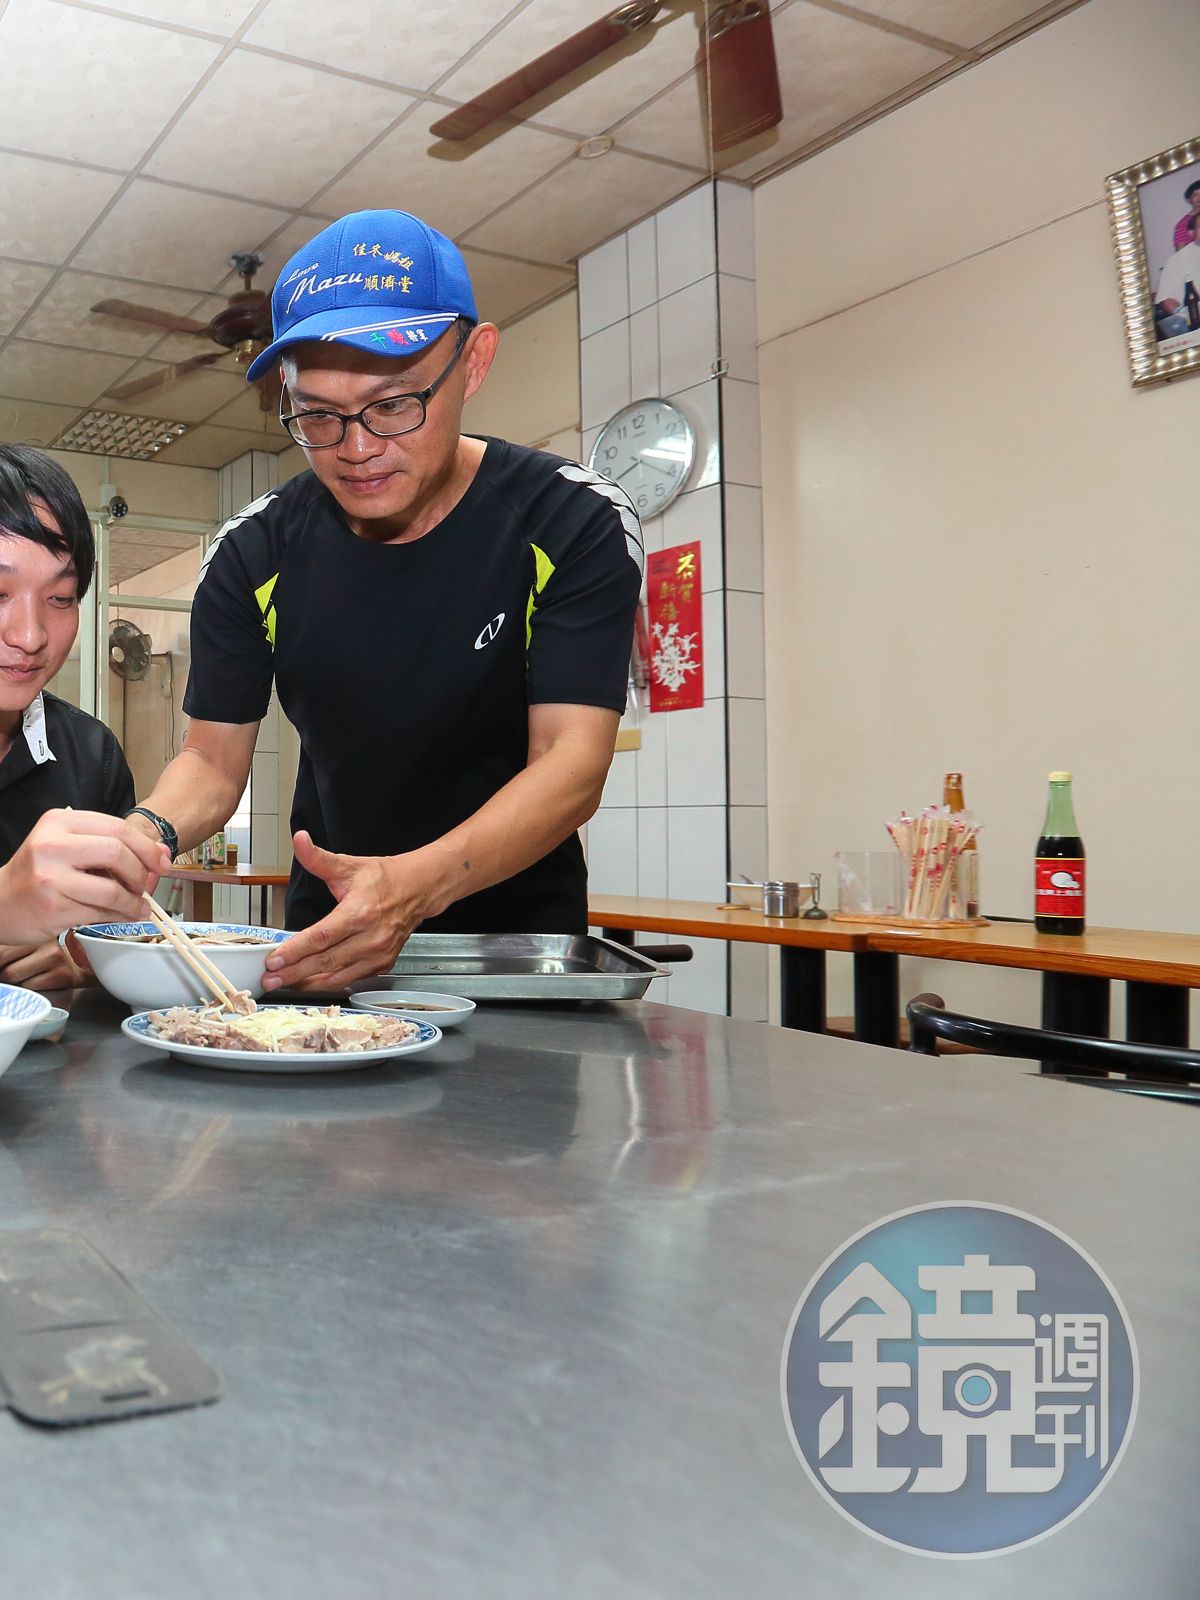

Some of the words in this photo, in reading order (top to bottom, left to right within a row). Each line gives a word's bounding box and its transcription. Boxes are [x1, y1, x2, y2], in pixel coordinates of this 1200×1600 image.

[286, 272, 364, 314] Mazu
[632, 414, 646, 430] 12
[617, 425, 627, 441] 11
[603, 445, 619, 460] 10
[655, 482, 666, 497] 5
[637, 494, 648, 508] 6
